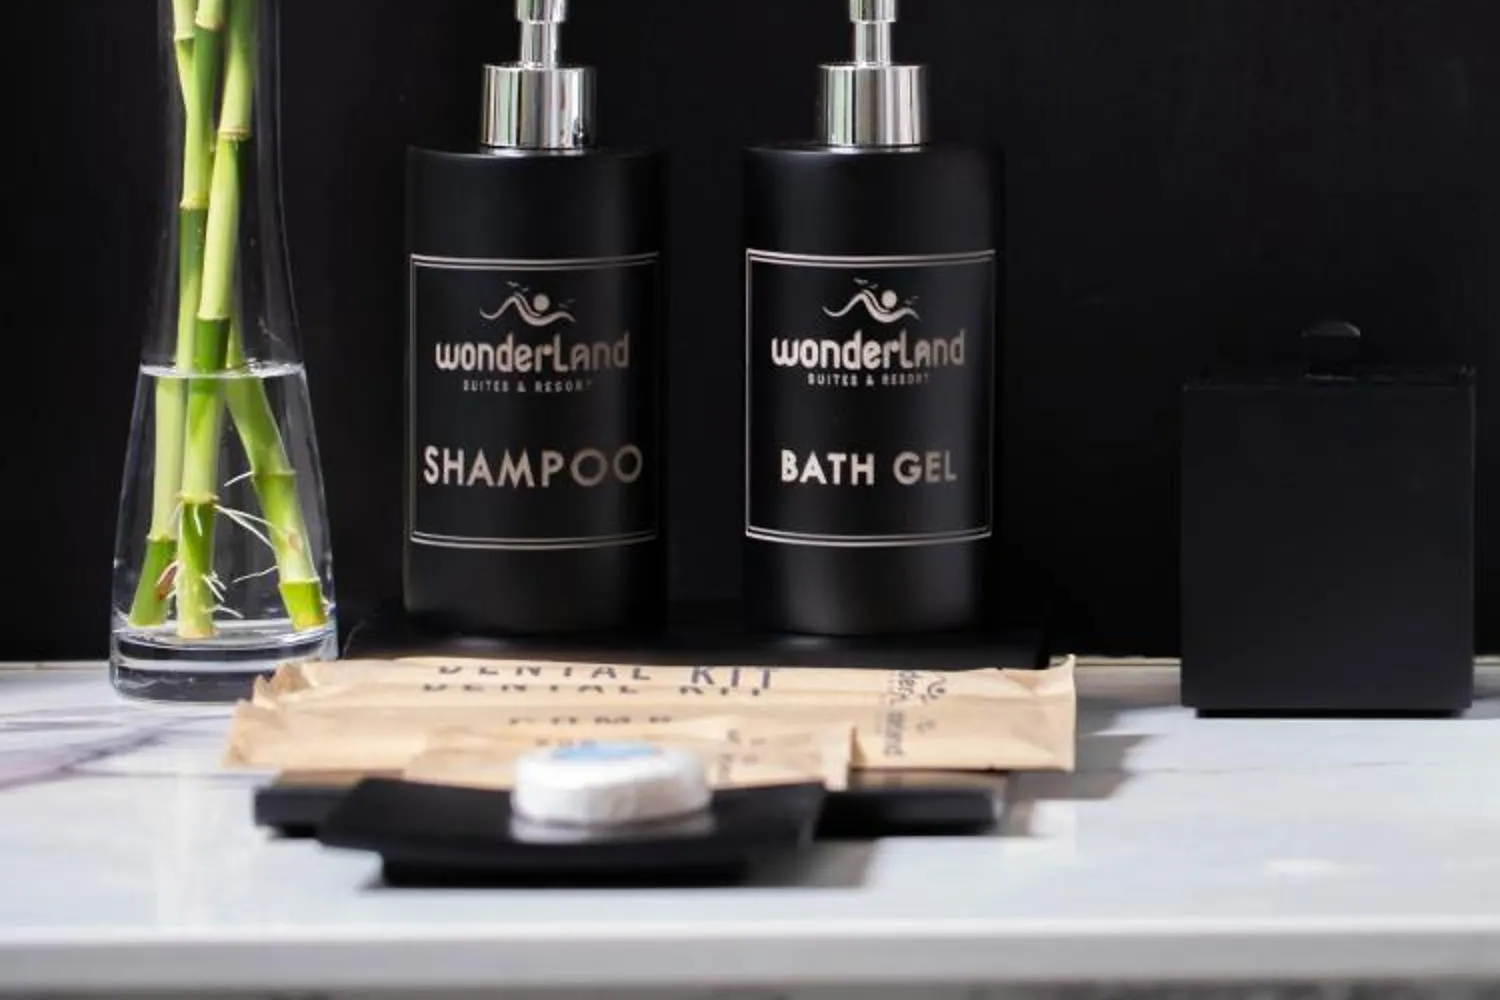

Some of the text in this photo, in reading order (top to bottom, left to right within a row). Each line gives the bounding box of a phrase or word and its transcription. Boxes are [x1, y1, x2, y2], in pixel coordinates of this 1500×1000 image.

[463, 379, 509, 393] SUITES
[535, 378, 593, 393] RESORT
[807, 372, 930, 387] SUITES & RESORT
[423, 444, 643, 488] SHAMPOO
[781, 449, 957, 486] BATH GEL
